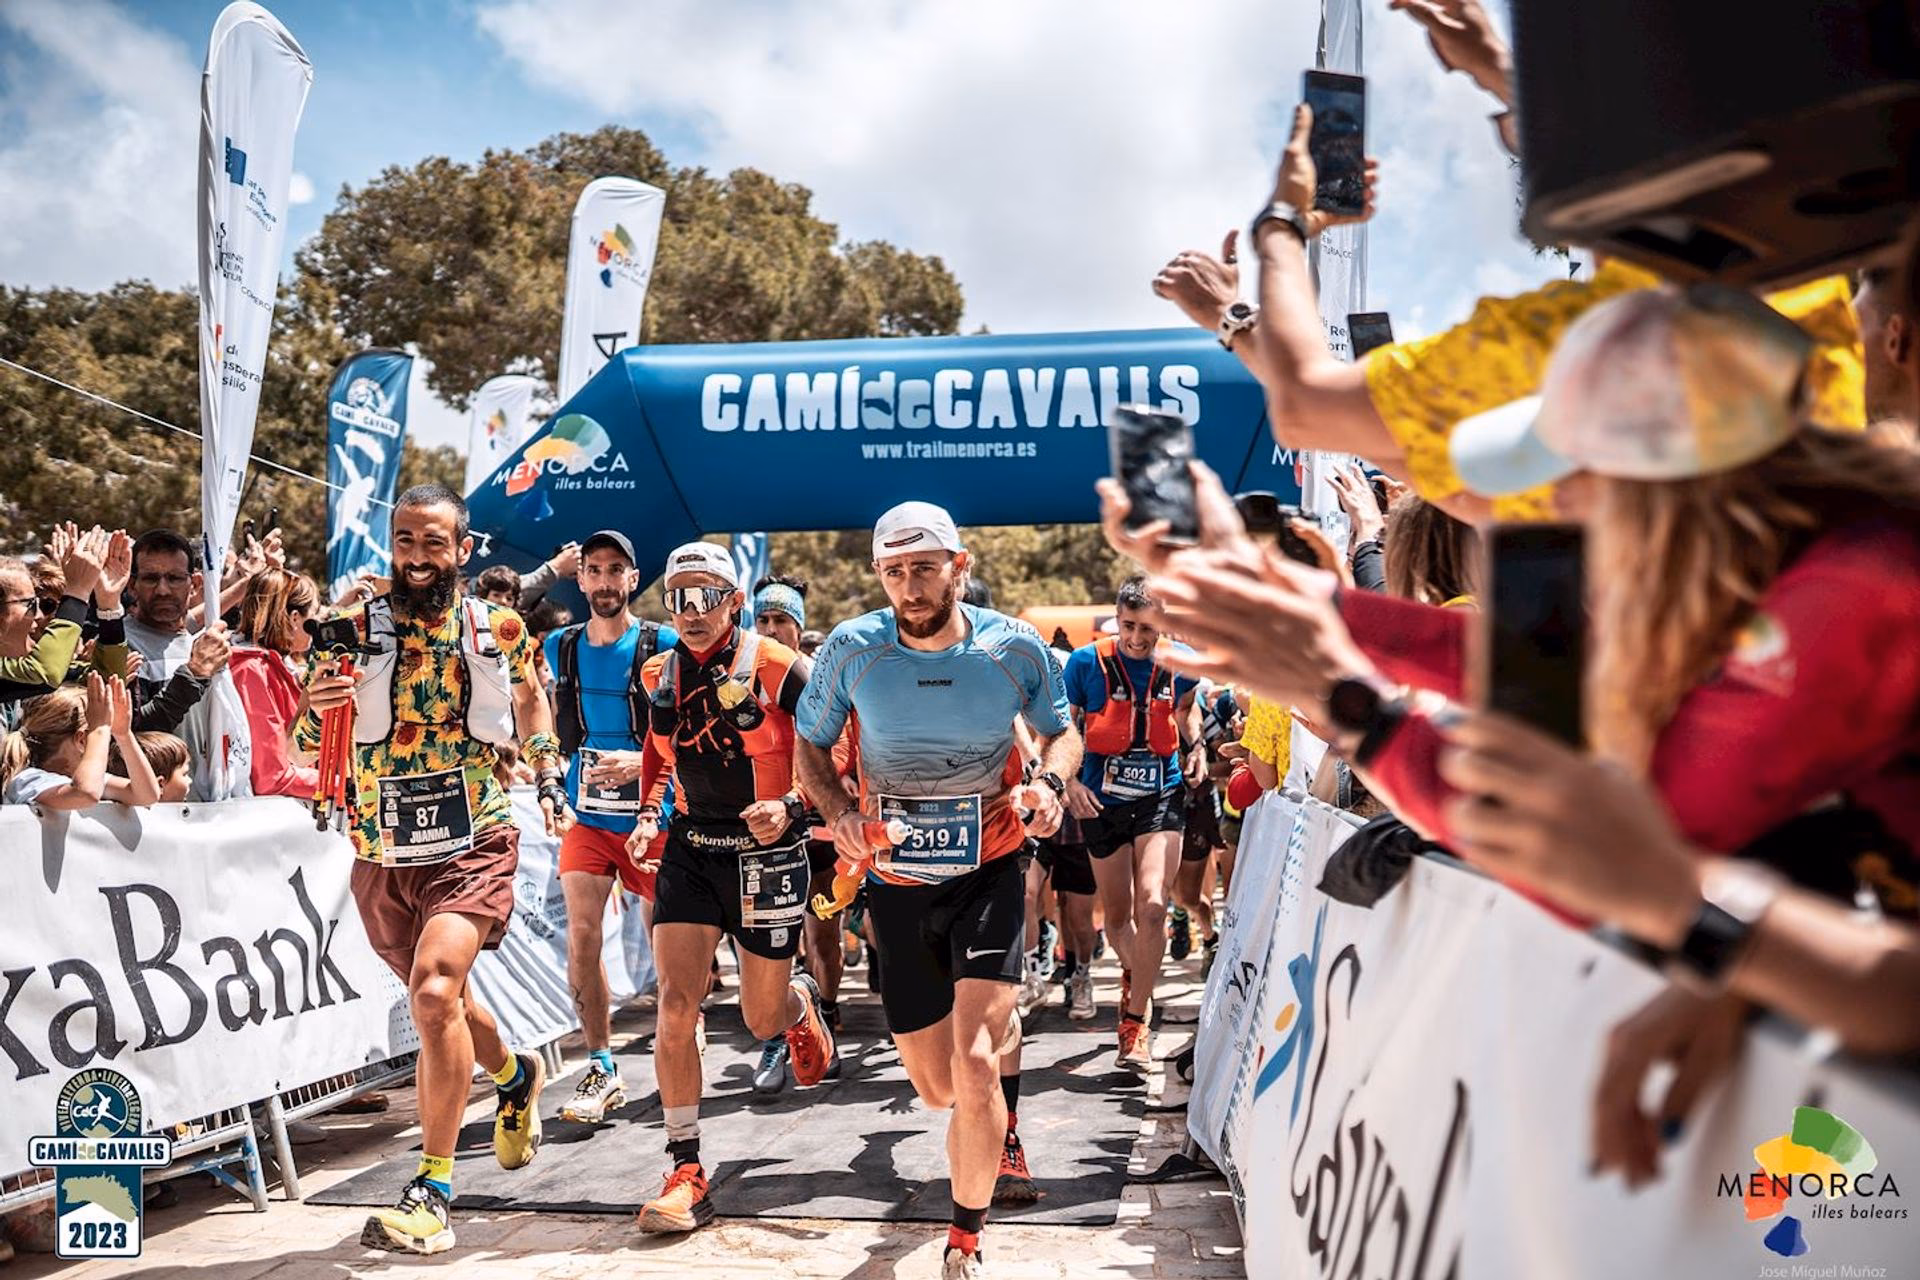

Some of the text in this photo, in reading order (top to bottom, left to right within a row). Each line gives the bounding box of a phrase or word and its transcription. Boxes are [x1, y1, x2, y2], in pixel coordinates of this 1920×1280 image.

[862, 439, 1037, 460] www.trailmenorca.es
[491, 452, 630, 487] MENOCA
[555, 476, 636, 490] illes balears
[1123, 766, 1146, 781] 502
[416, 805, 440, 828] 87
[409, 825, 451, 844] JUANMA
[686, 830, 751, 847] Columbus
[911, 826, 969, 849] 519 A
[781, 874, 792, 894] 5
